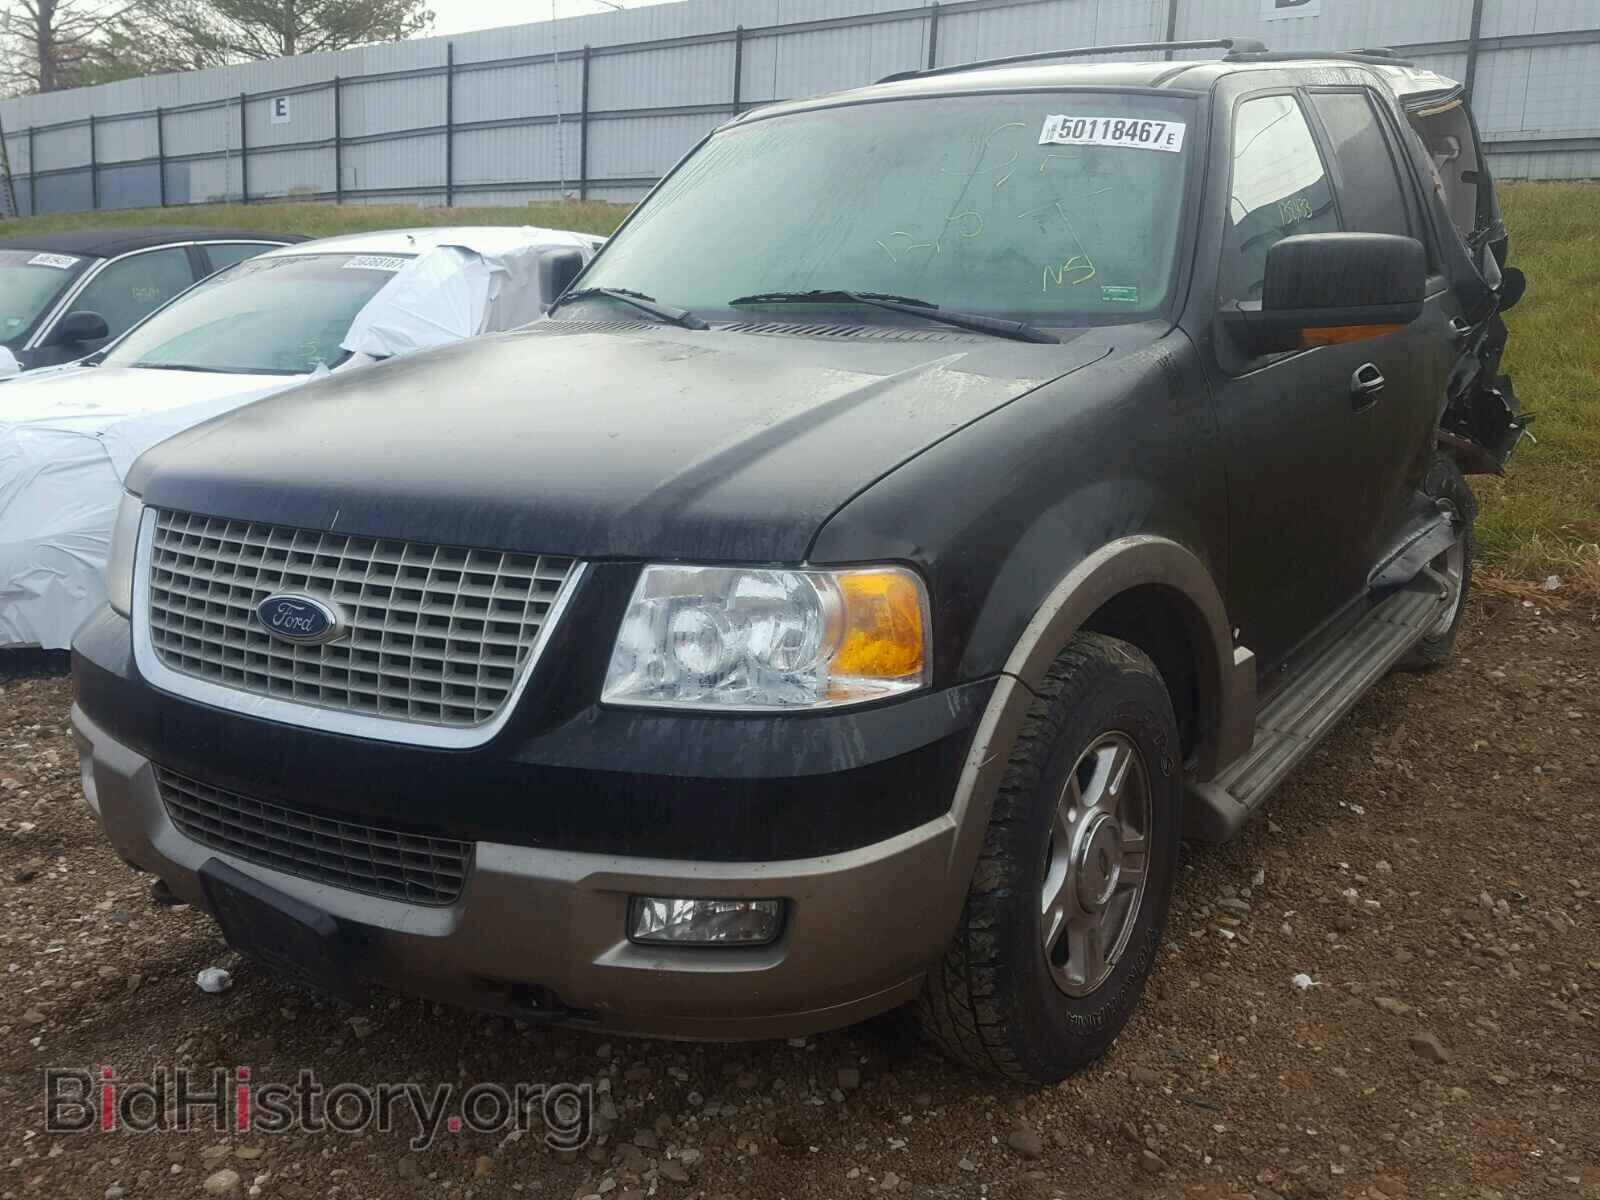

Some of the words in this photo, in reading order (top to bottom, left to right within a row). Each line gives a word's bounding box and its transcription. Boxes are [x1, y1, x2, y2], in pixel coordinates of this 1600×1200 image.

[276, 98, 287, 116] E
[1058, 118, 1167, 144] 50118467
[1166, 132, 1176, 145] E
[272, 602, 316, 631] Ford
